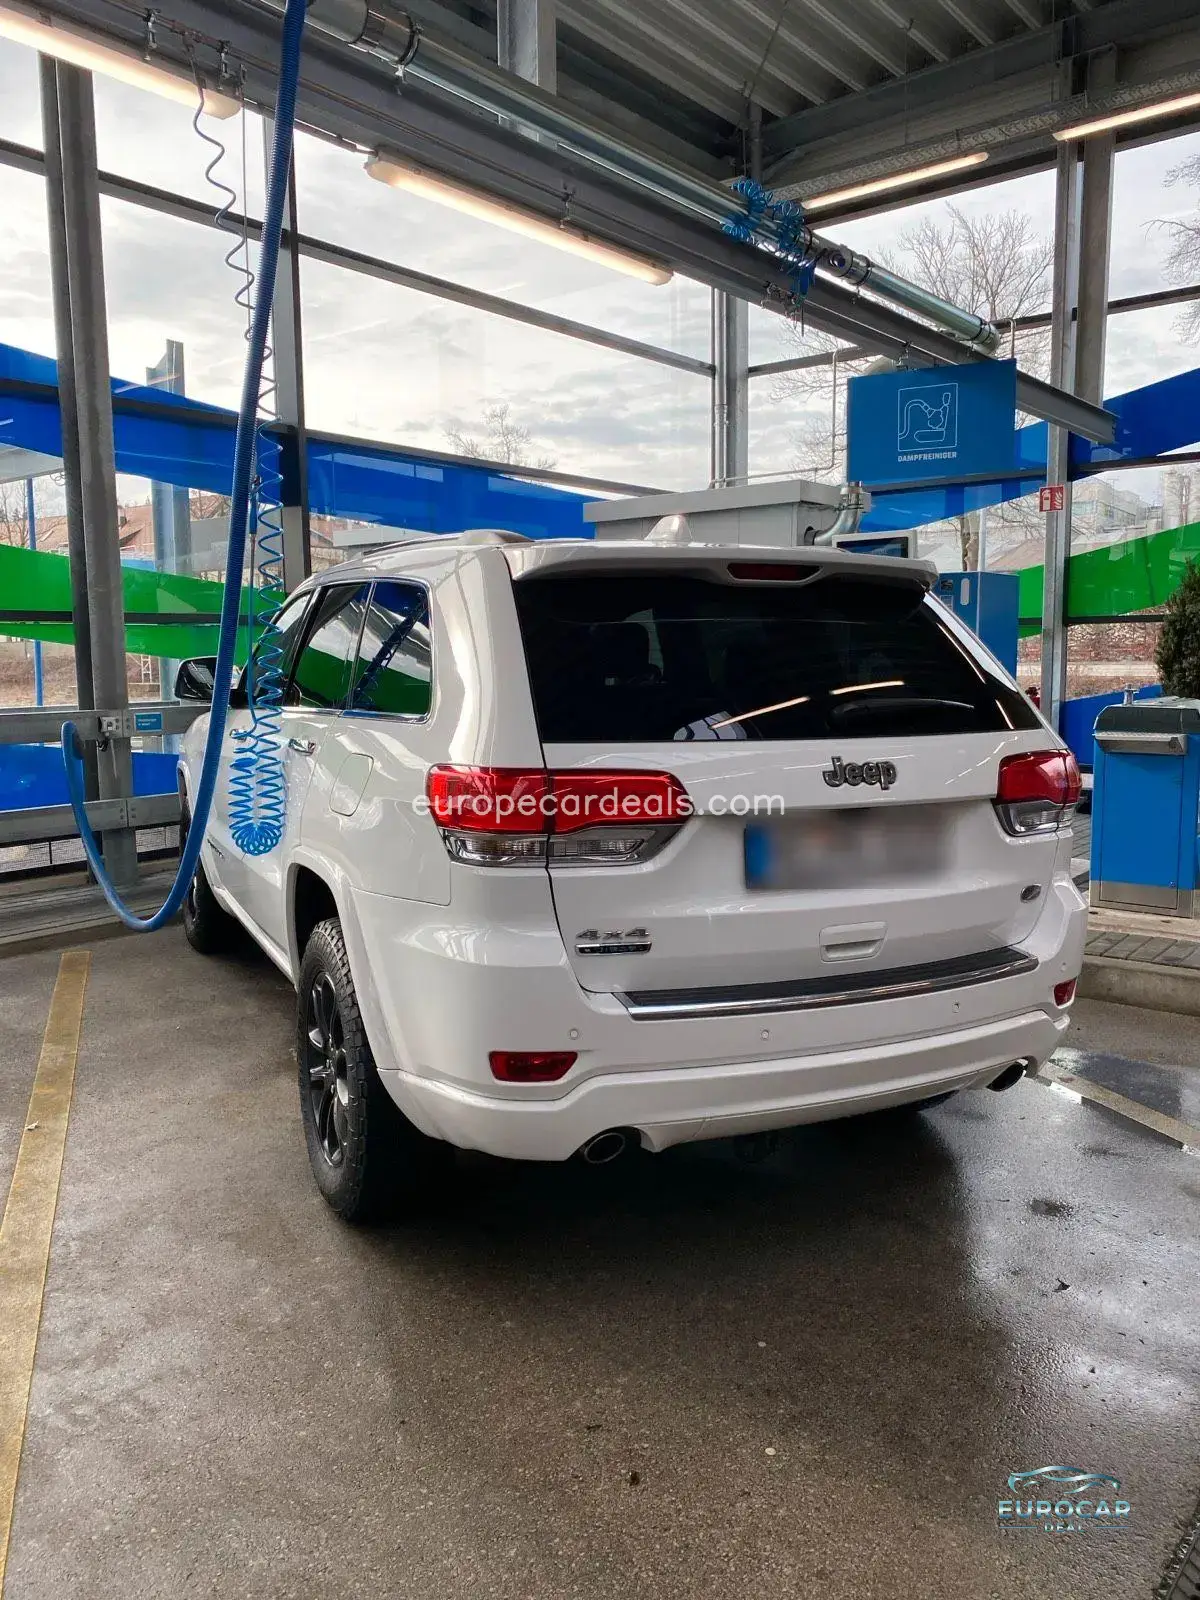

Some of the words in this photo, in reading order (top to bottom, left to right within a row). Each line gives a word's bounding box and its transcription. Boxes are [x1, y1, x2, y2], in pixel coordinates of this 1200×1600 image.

[897, 451, 957, 462] DAMPFREINIGER
[822, 755, 897, 791] Jeep
[575, 927, 650, 941] 4x4
